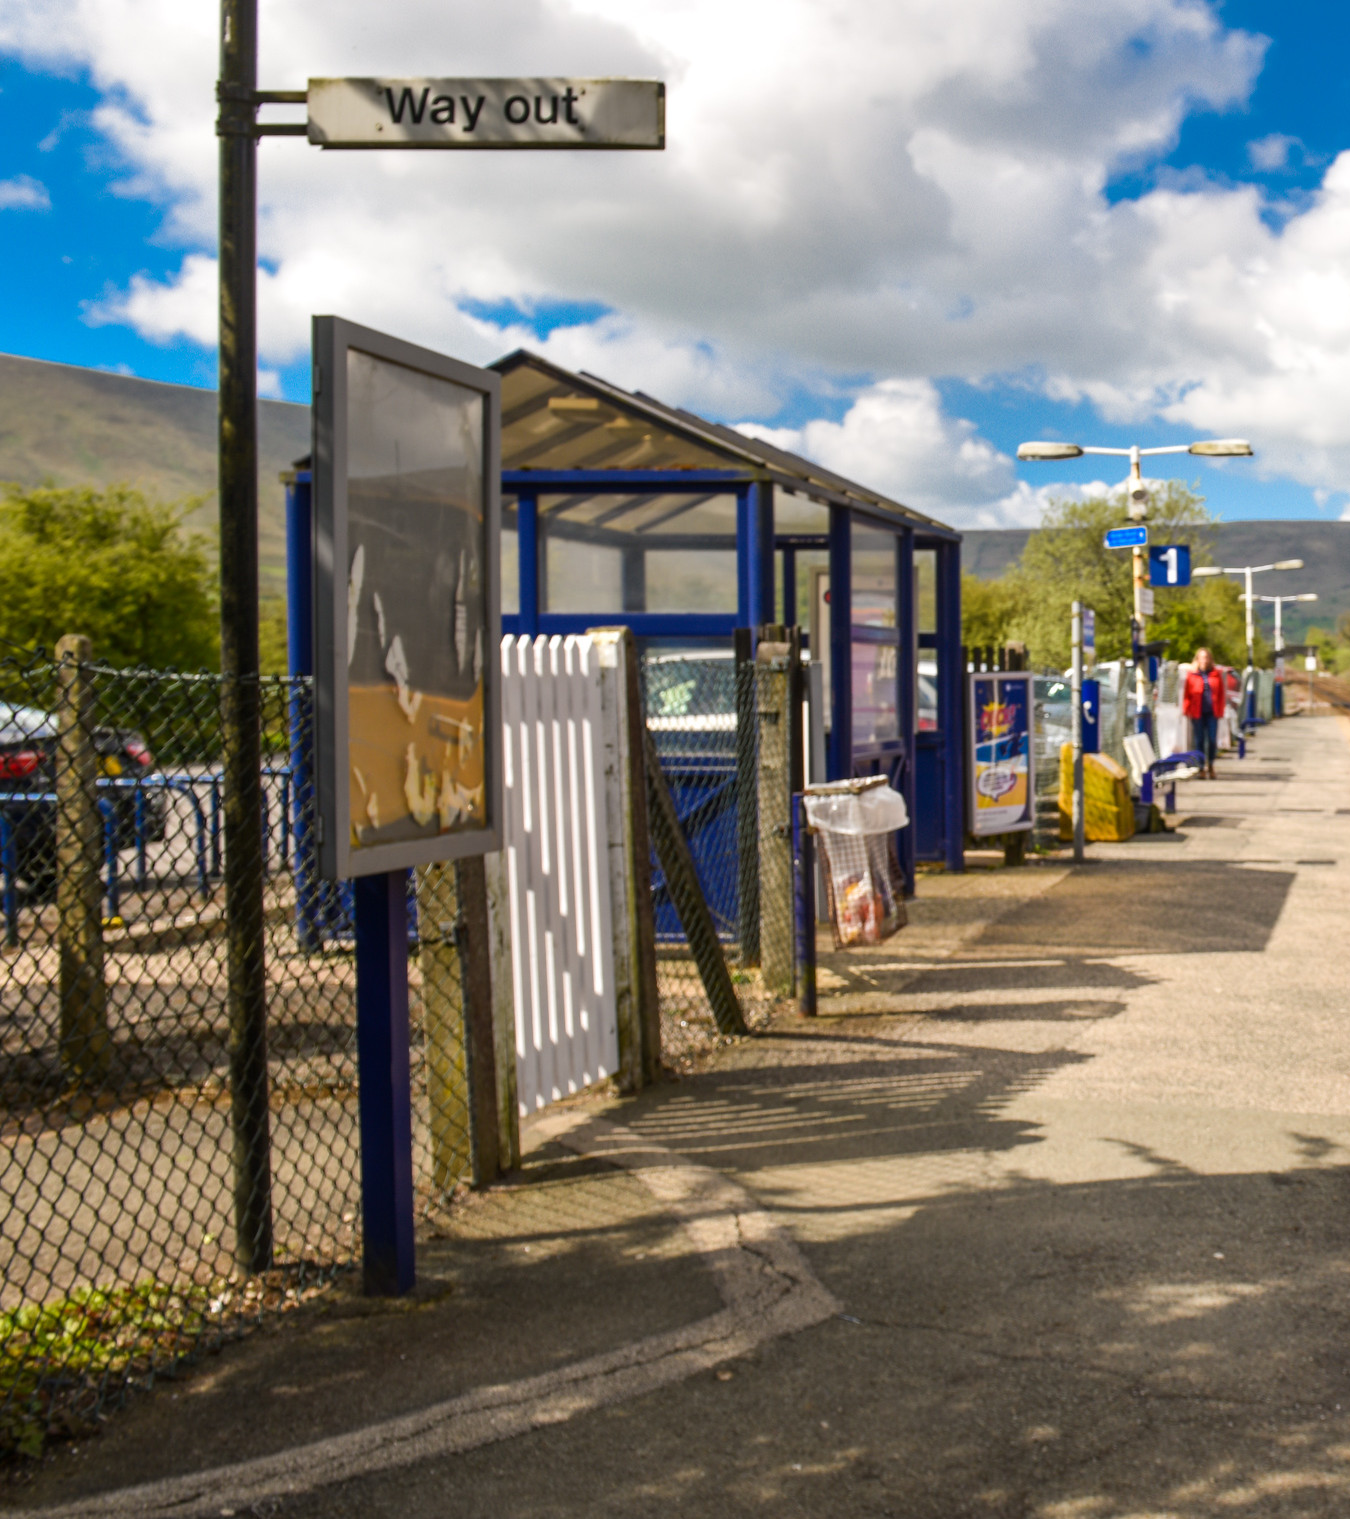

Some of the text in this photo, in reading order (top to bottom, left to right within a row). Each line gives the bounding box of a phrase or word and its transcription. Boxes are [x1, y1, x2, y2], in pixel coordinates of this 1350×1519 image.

[386, 87, 578, 132] Way out
[1159, 547, 1178, 584] 1
